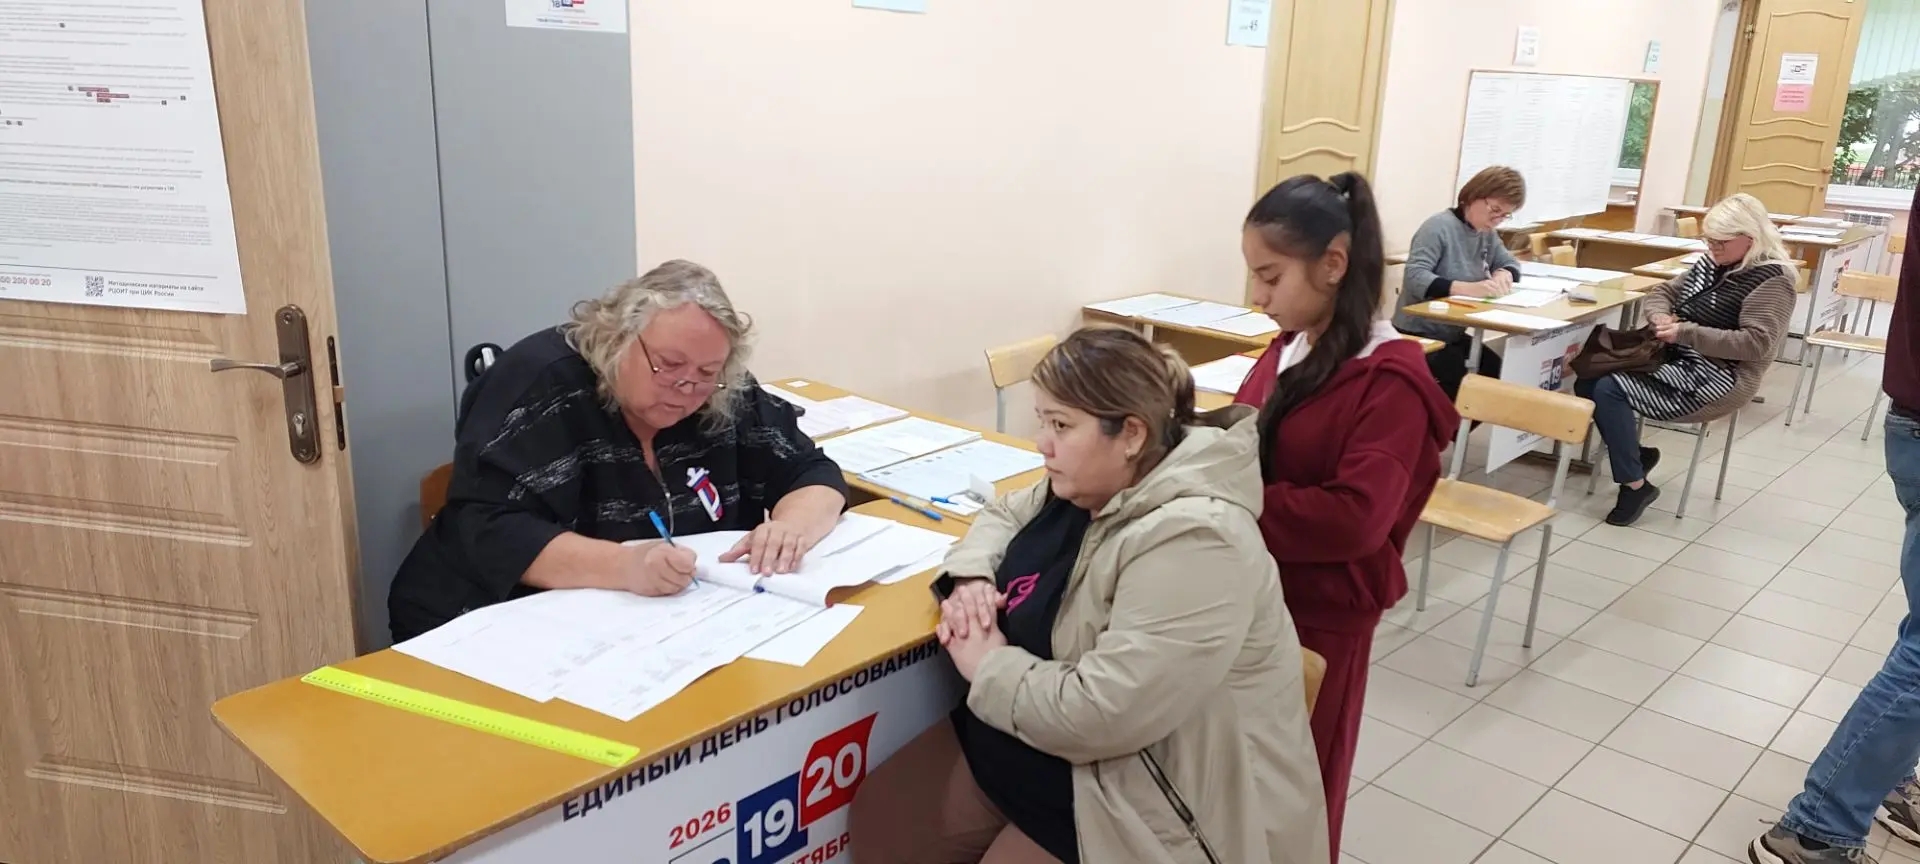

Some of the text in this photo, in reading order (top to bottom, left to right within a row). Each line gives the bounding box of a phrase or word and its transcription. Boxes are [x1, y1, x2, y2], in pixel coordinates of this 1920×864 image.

[12, 276, 28, 285] 200
[29, 278, 40, 286] 00
[41, 278, 52, 287] 20
[562, 744, 692, 822] ЕДИНЫЙ
[699, 713, 769, 764] ДЕНЬ
[776, 640, 939, 725] ГОЛОСОВАНИЯ
[805, 741, 863, 808] 20
[669, 802, 732, 850] 2026
[743, 798, 795, 860] 19
[792, 831, 850, 864] ТЯБР
